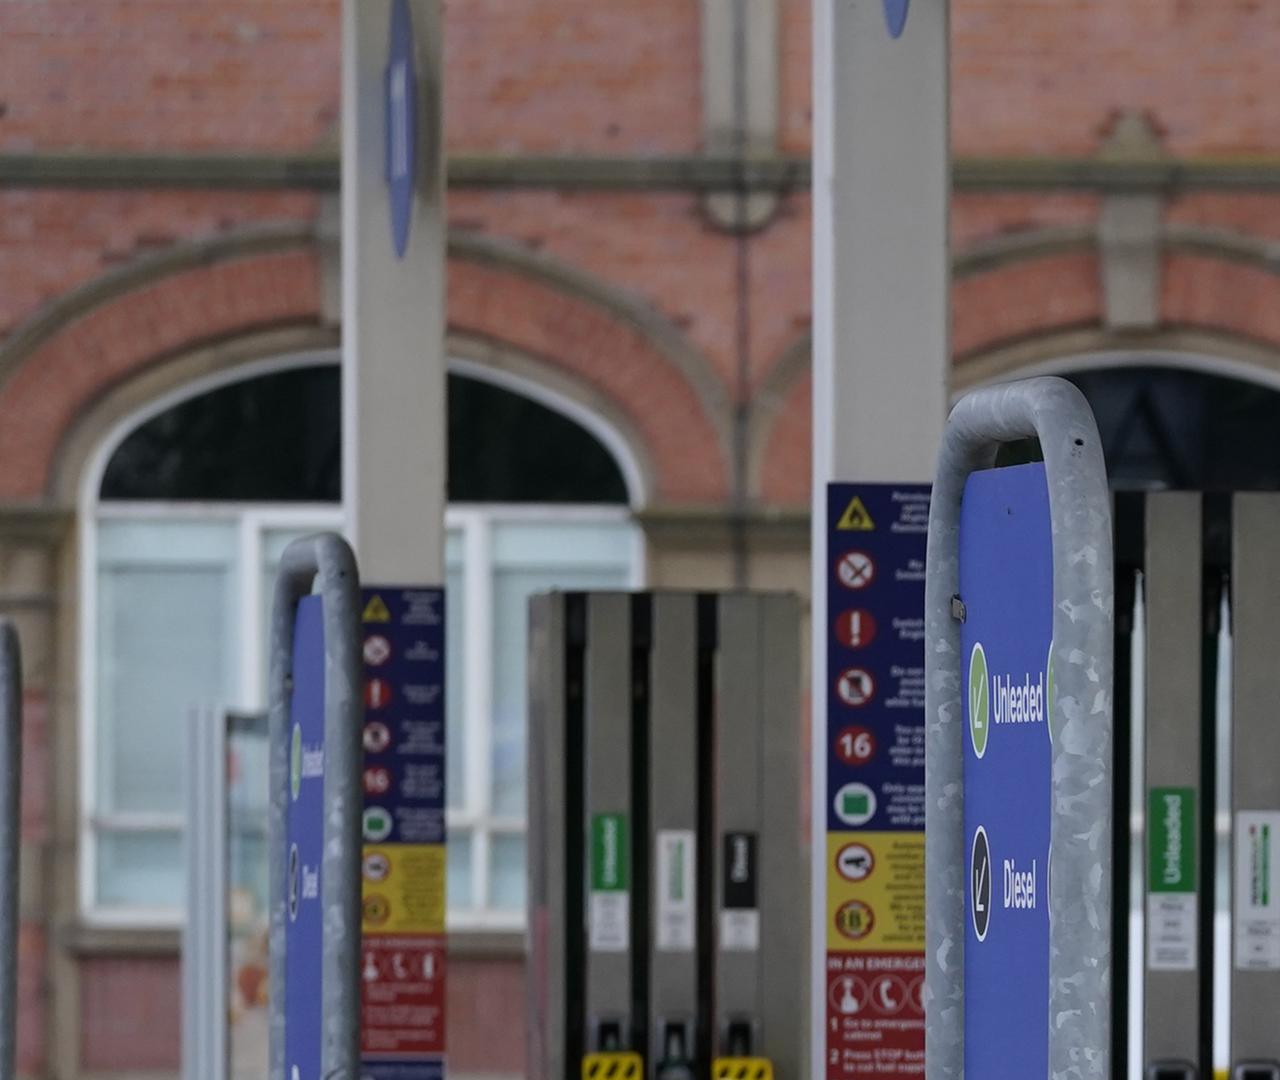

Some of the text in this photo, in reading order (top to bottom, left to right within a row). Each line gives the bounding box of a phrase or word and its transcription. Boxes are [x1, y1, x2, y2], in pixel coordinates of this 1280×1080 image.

[991, 672, 1045, 727] Unleaded
[842, 733, 871, 759] 16
[1162, 793, 1183, 886] Unleaded
[1002, 858, 1037, 912] Diesel
